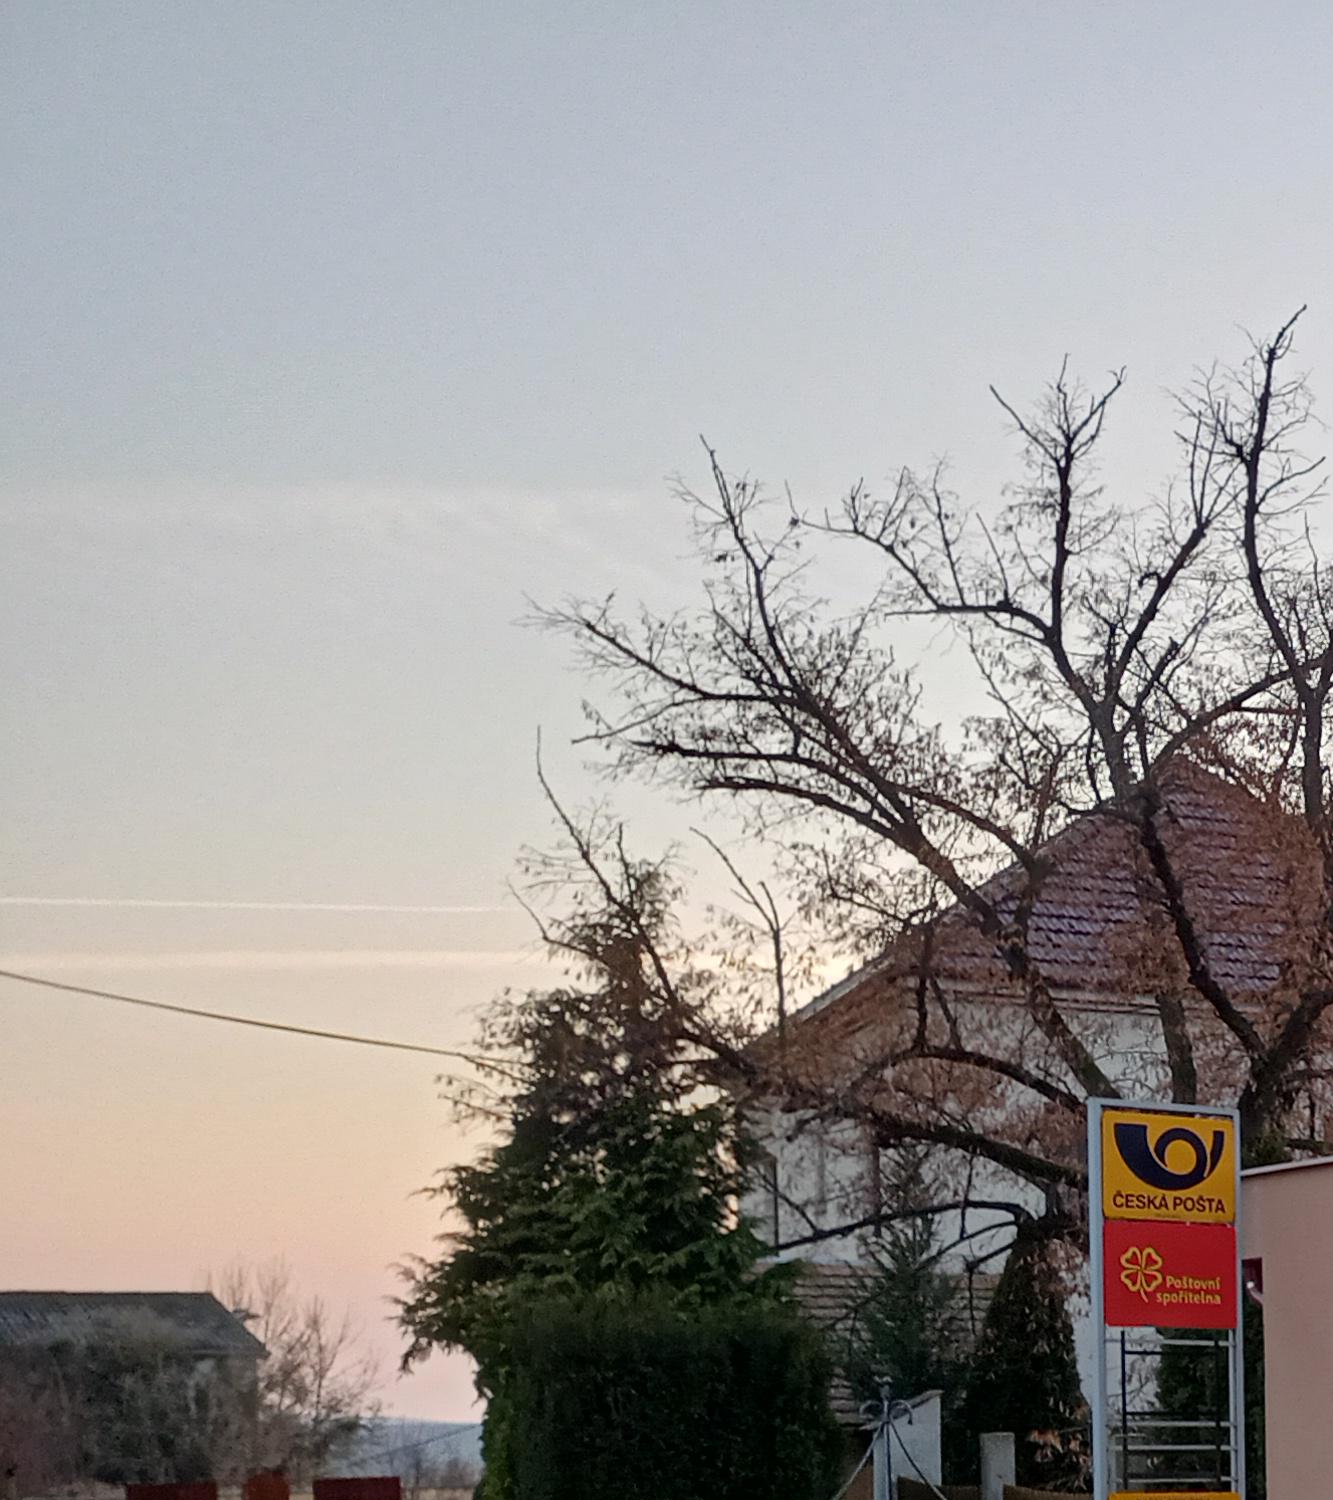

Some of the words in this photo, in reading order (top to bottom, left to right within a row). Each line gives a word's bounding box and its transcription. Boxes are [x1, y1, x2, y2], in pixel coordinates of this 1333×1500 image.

[1113, 1190, 1169, 1210] ČESKÁ
[1173, 1195, 1226, 1214] POŠTA
[1166, 1275, 1220, 1290] Poštovní
[1155, 1290, 1221, 1306] spořitelna
